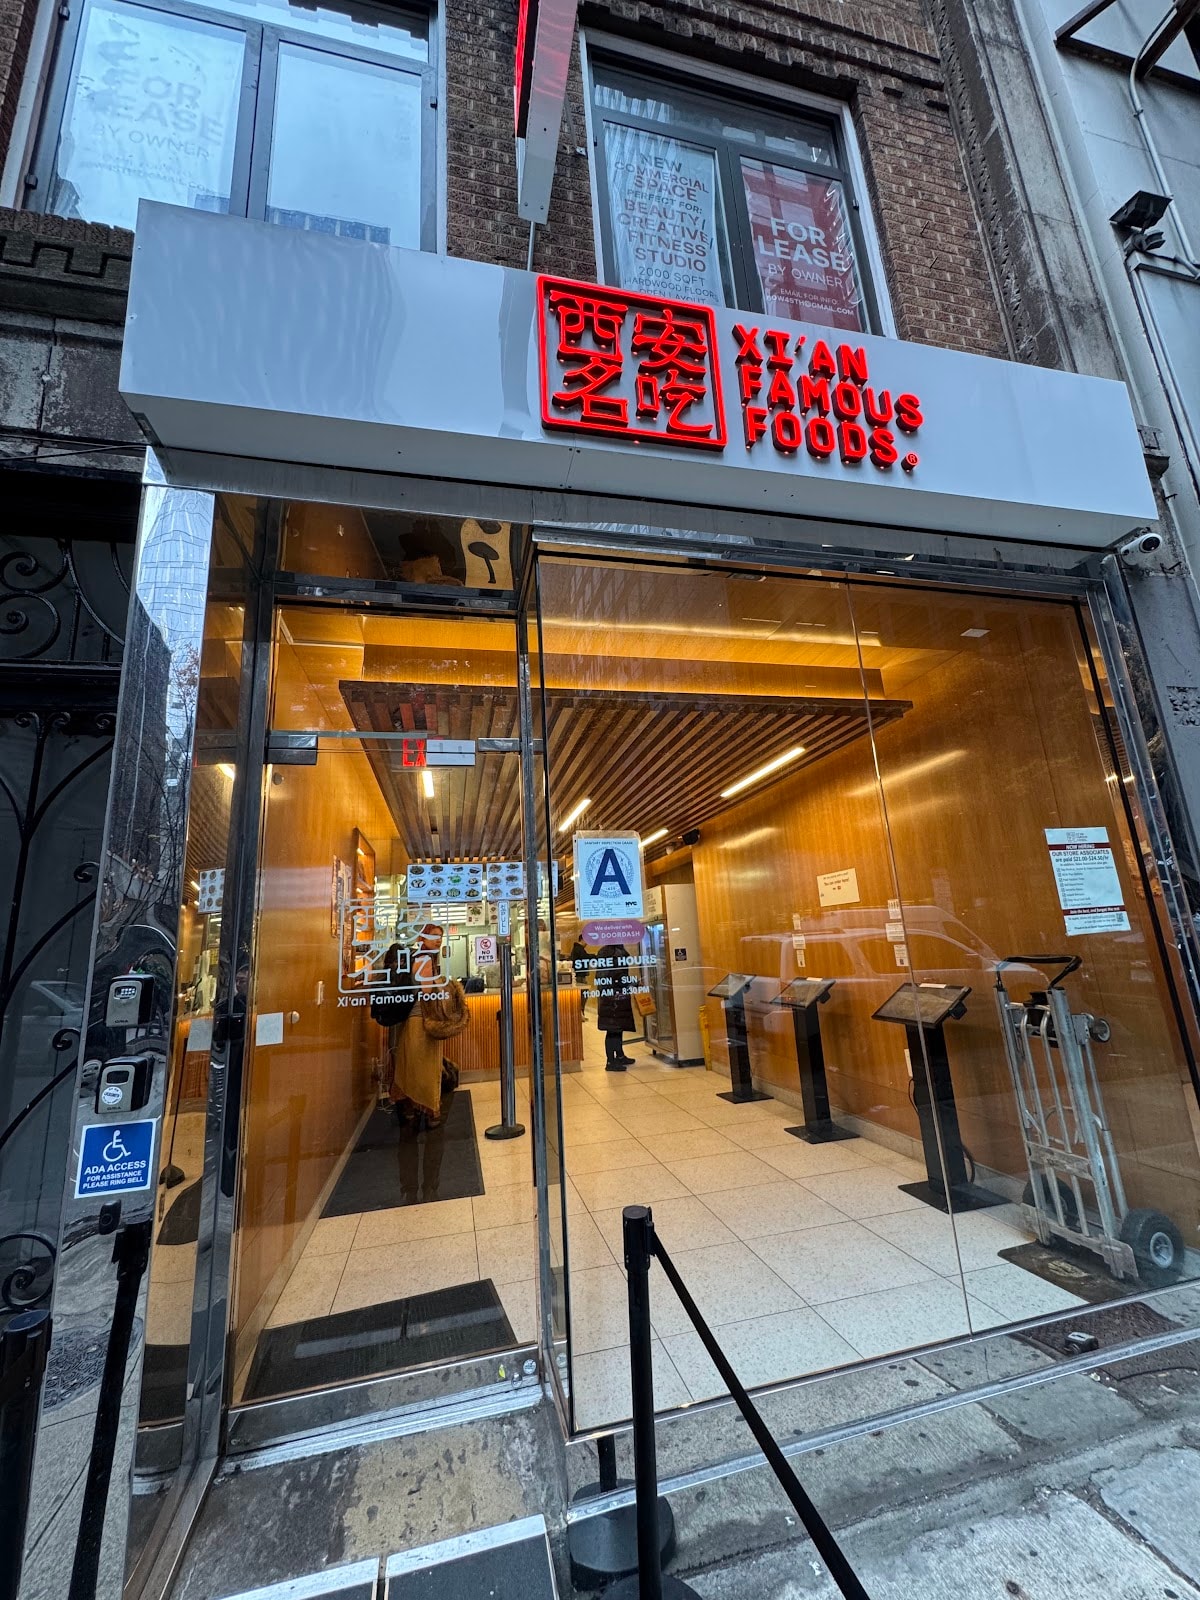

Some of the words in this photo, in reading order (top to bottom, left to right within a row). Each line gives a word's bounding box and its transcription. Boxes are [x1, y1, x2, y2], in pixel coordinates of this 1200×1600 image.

[128, 129, 210, 161] OWNER
[640, 153, 683, 173] NEW
[614, 161, 710, 194] COMMERCIAL
[634, 175, 698, 202] SPACE
[627, 189, 676, 204] PERFECT
[679, 201, 703, 215] FOR:
[628, 229, 707, 258] FITNESS
[770, 216, 827, 247] FOR
[634, 247, 706, 273] STUDIO
[757, 235, 845, 272] LEASE
[624, 277, 683, 292] HARDWOOD
[638, 266, 671, 280] 2000
[673, 272, 706, 287] SQFT
[768, 263, 786, 276] BY
[791, 268, 843, 289] OWNER
[780, 288, 802, 299] EMAIL
[803, 293, 819, 301] FOR
[549, 289, 708, 374] 西安
[732, 323, 869, 386] XI'AN
[552, 357, 713, 436] 名吃
[738, 364, 924, 432] FAMOUS
[590, 849, 632, 895] A
[349, 901, 442, 946] 西安
[601, 931, 640, 939] DOORDASH
[574, 957, 614, 969] STORE
[617, 954, 657, 966] HOURS
[583, 990, 600, 998] 11:00
[601, 988, 614, 997] AM
[622, 986, 638, 995] 8:30
[638, 985, 650, 993] PM
[594, 977, 613, 986] MON
[621, 975, 638, 984] SUN
[337, 997, 366, 1008] Xi'an
[370, 993, 415, 1005] Famous
[417, 990, 450, 1002] Foods
[84, 1165, 106, 1175] ADA
[106, 1160, 147, 1172] ACCESS
[101, 1170, 142, 1180] ASSISTANCE
[82, 1180, 109, 1189] PLEASE
[127, 1176, 144, 1184] BELL
